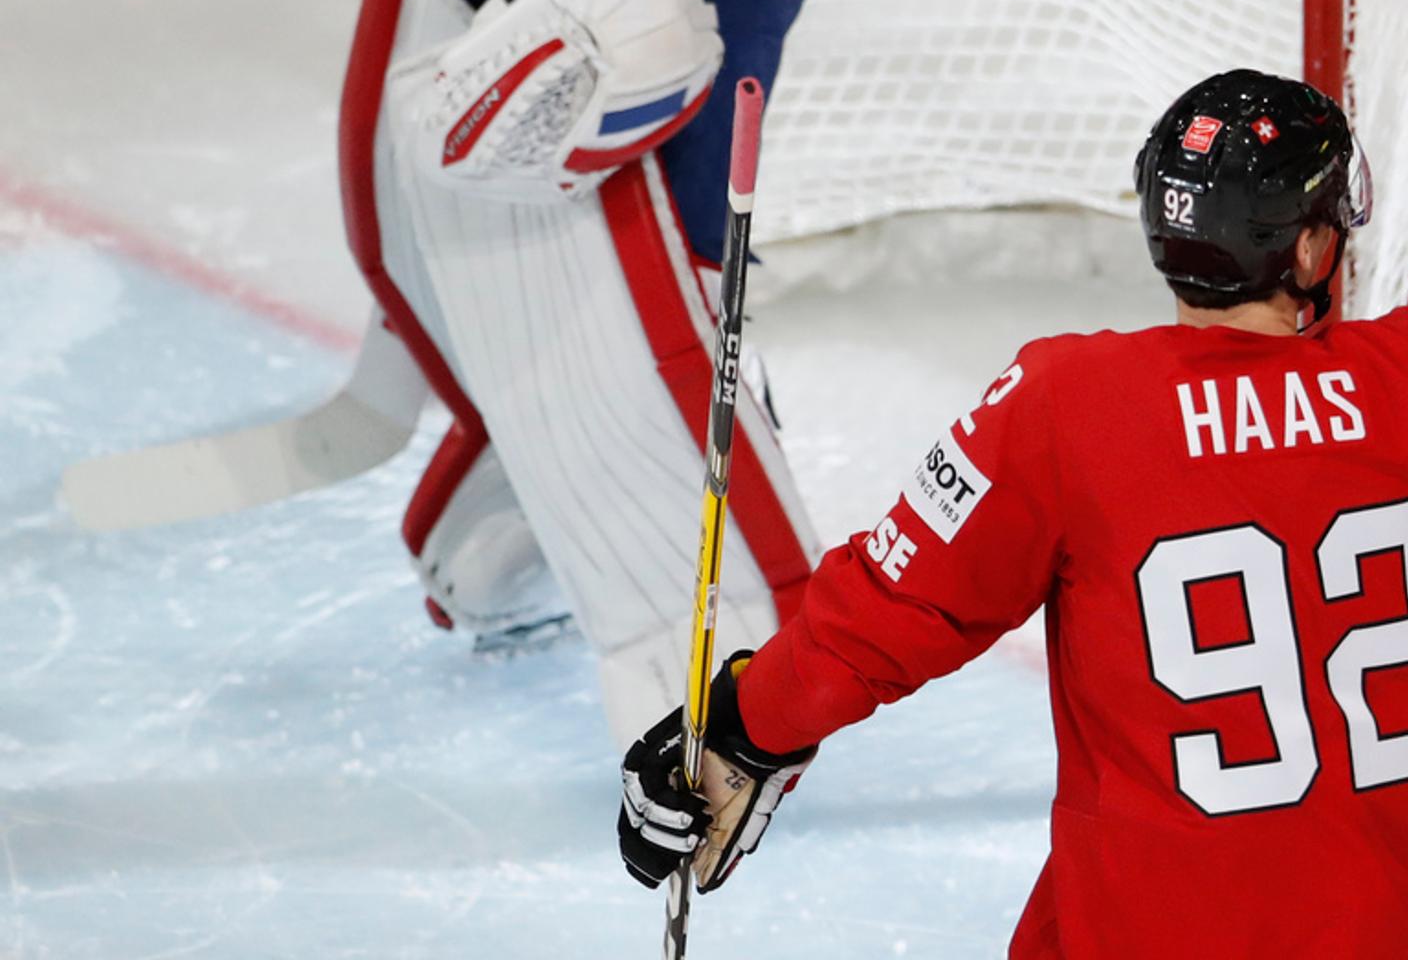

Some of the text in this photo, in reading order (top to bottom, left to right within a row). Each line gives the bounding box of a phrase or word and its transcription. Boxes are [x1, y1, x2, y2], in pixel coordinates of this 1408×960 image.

[1163, 188, 1196, 226] 92
[722, 332, 740, 406] CCM
[1176, 369, 1368, 458] HAAS
